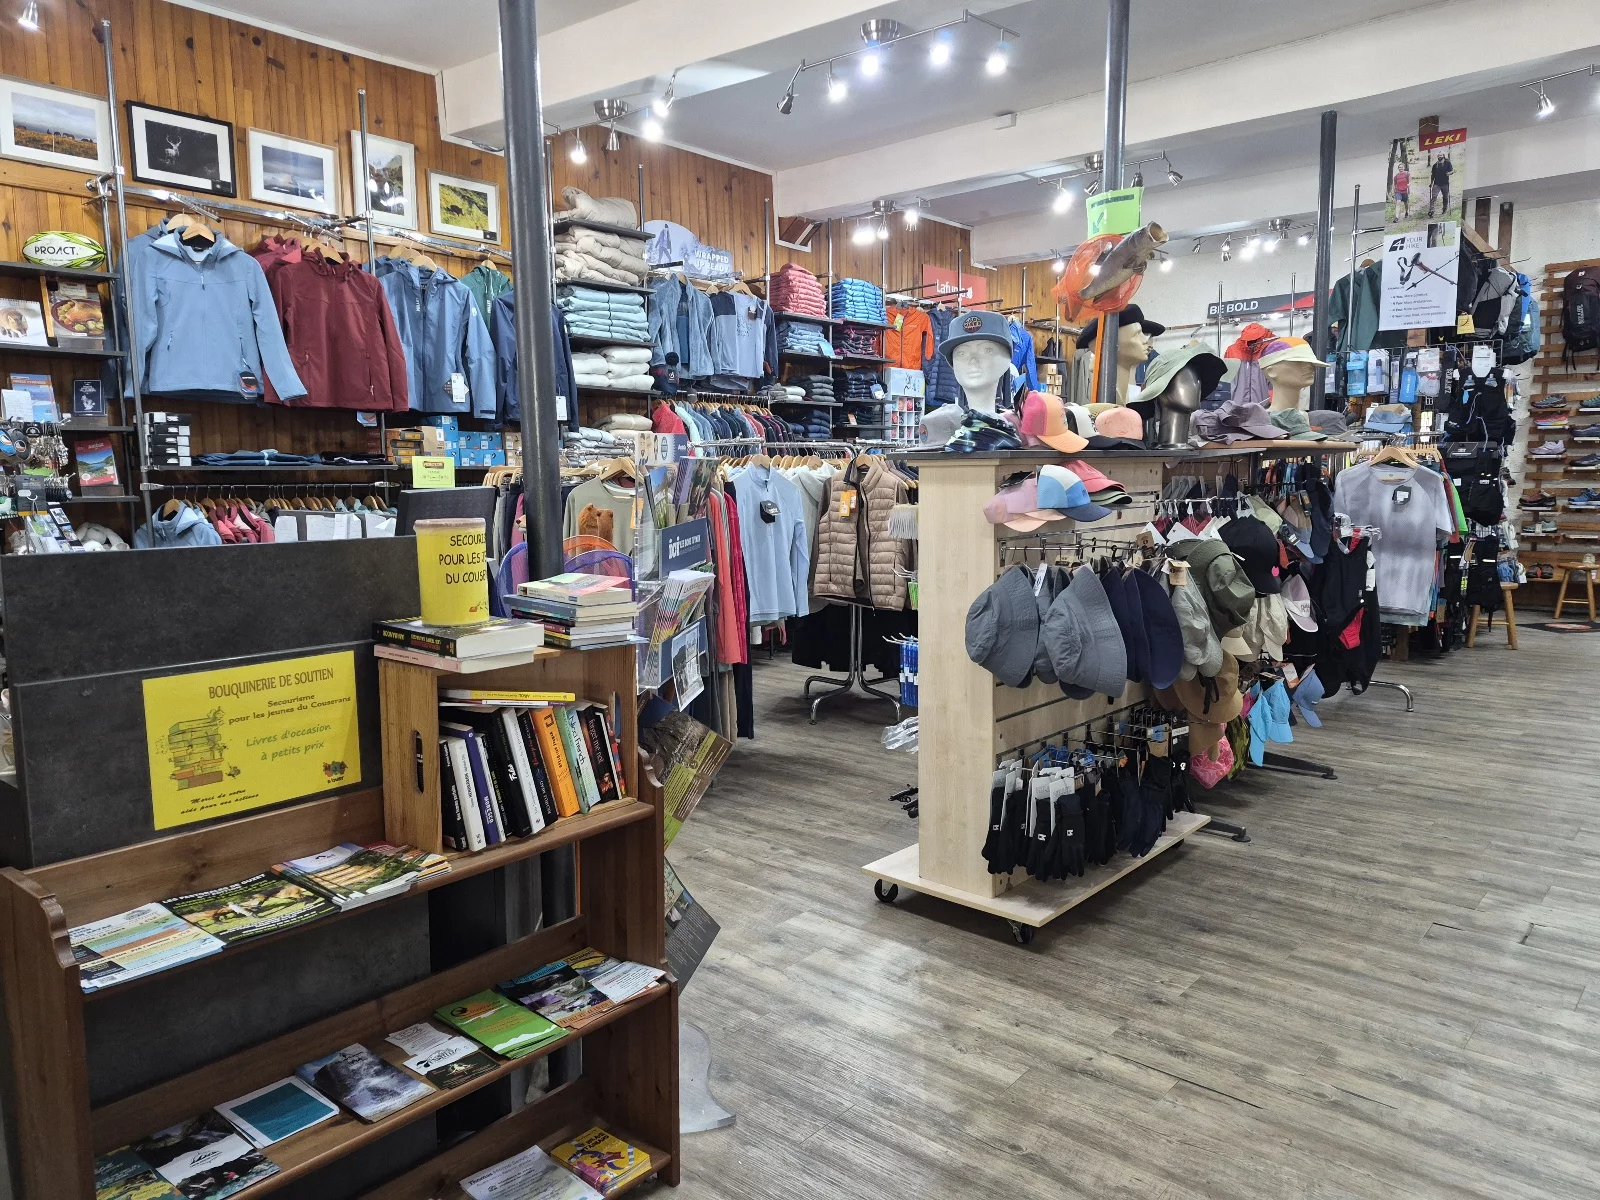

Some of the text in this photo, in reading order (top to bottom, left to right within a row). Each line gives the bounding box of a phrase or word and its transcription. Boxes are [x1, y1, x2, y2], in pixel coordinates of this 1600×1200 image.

[1424, 134, 1461, 146] LEKI
[695, 249, 729, 264] WRAPPED
[1209, 300, 1259, 315] BE BOLD
[438, 553, 465, 566] POUR
[466, 552, 480, 565] LES
[445, 573, 460, 584] DU
[208, 667, 334, 699] BOUQUINERIE DE SOUTIEN
[267, 694, 315, 708] Secourisme
[228, 696, 351, 725] pour les jeunes du Couserans
[569, 715, 578, 737] Nicci
[246, 722, 332, 747] Livres d'occasion
[260, 740, 325, 762] à petits prix
